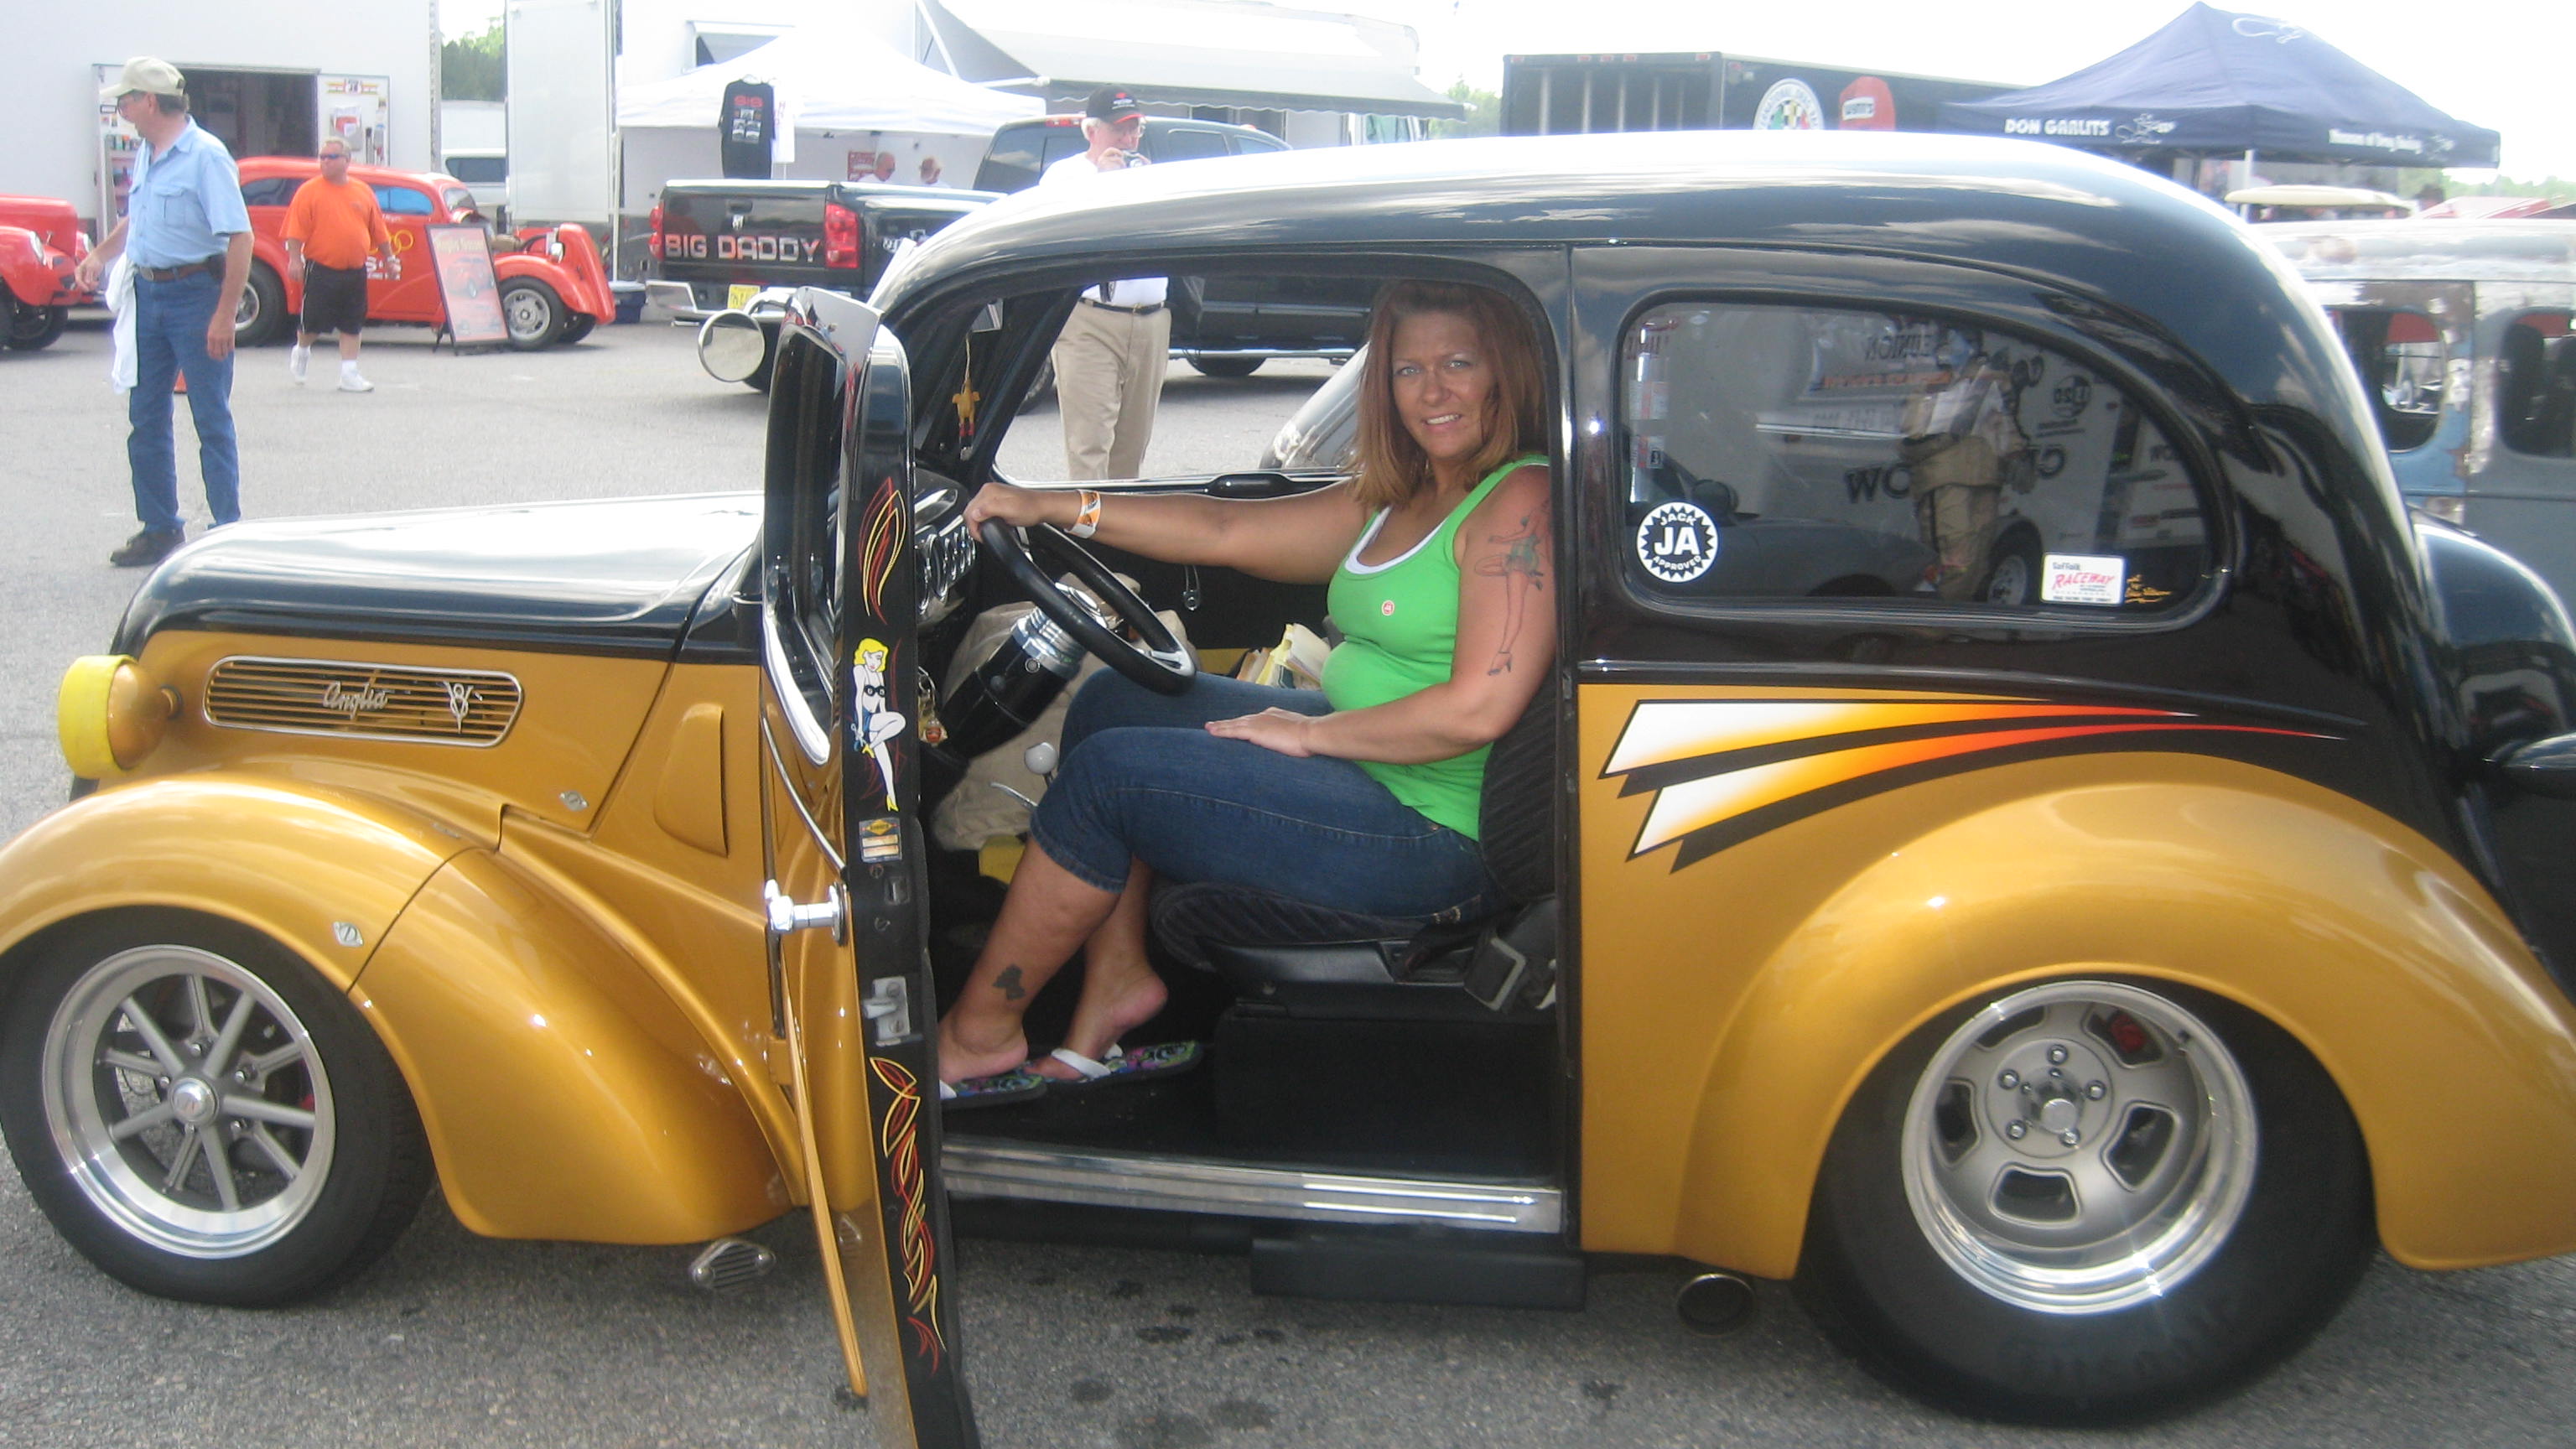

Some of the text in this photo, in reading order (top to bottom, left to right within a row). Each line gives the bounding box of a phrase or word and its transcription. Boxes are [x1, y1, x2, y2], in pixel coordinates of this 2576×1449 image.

[2004, 119, 2111, 137] DON GARLITS
[665, 234, 820, 262] BIG DADDY
[1660, 512, 1697, 527] JACK
[1654, 527, 1701, 556] JA
[1652, 554, 1702, 570] APPROVED
[2052, 572, 2115, 590] RACEWAY
[321, 680, 388, 721] Anglia
